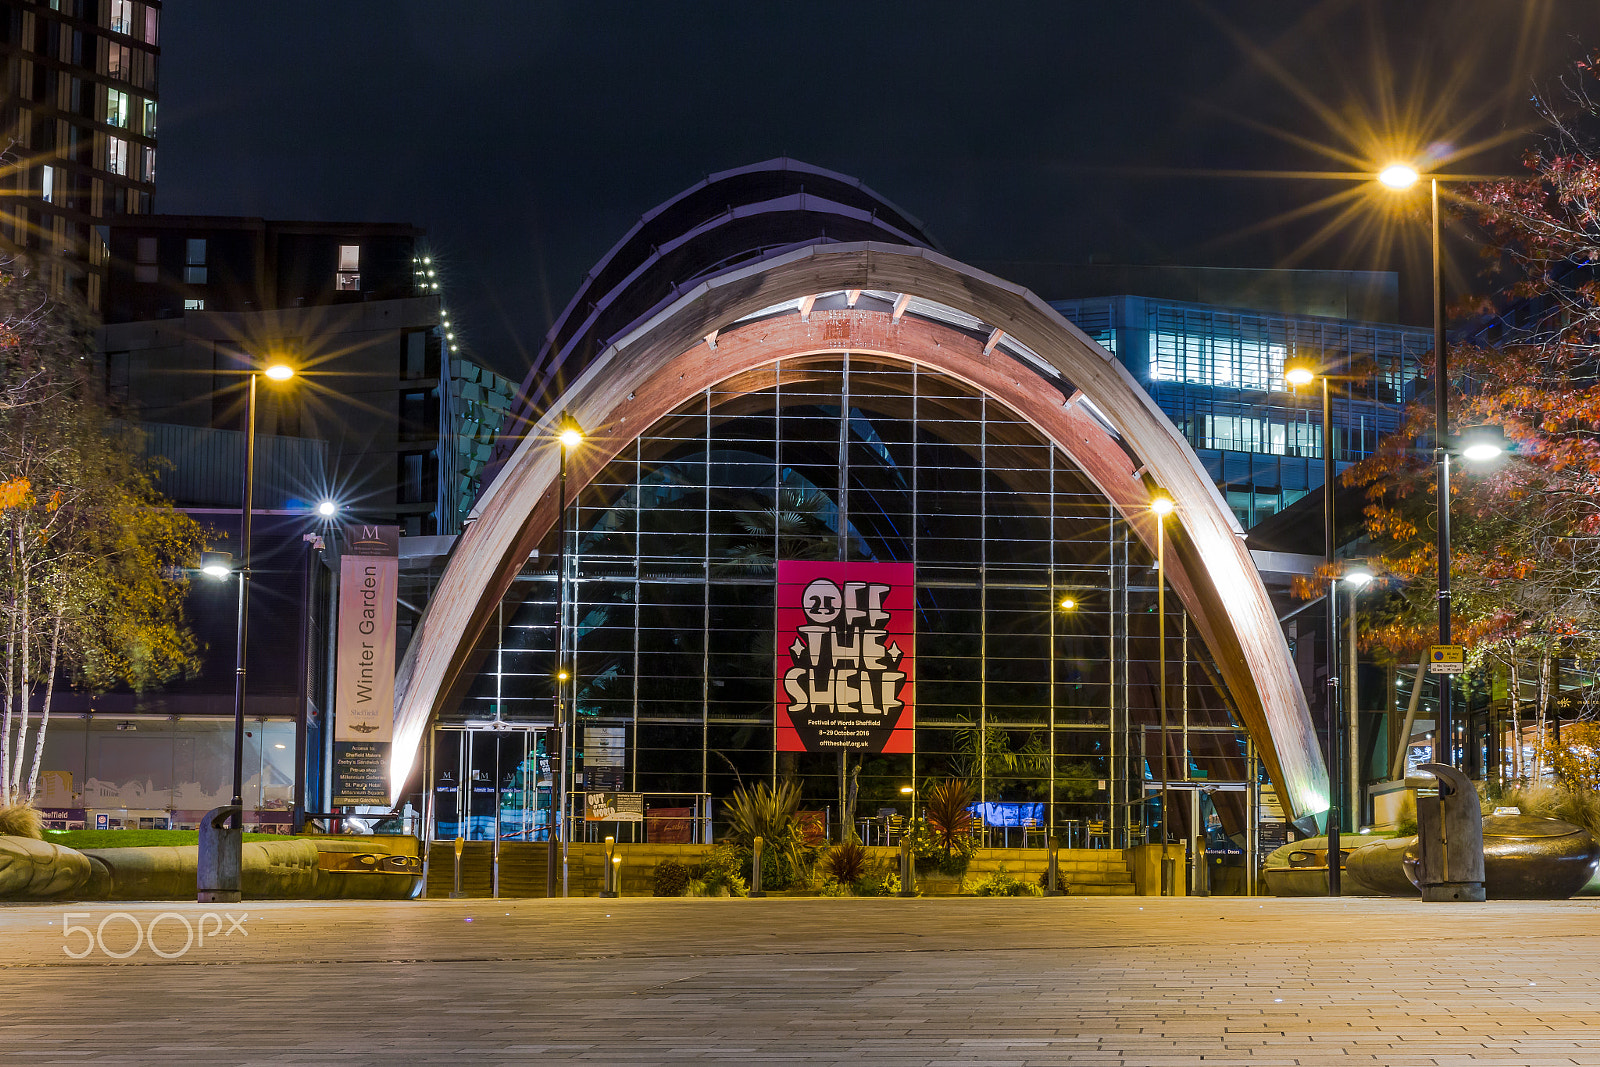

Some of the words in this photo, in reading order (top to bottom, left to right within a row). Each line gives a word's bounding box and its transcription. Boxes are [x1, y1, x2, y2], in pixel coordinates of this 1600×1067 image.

[362, 525, 380, 540] M
[359, 565, 377, 635] Garden
[802, 578, 891, 627] OFF
[809, 595, 836, 615] 25
[798, 625, 888, 670] THE
[356, 641, 374, 704] Winter
[783, 667, 905, 716] SHELF
[819, 740, 869, 748] offtheshelf.org.uk
[588, 793, 604, 806] OUT
[593, 807, 615, 818] WORLD
